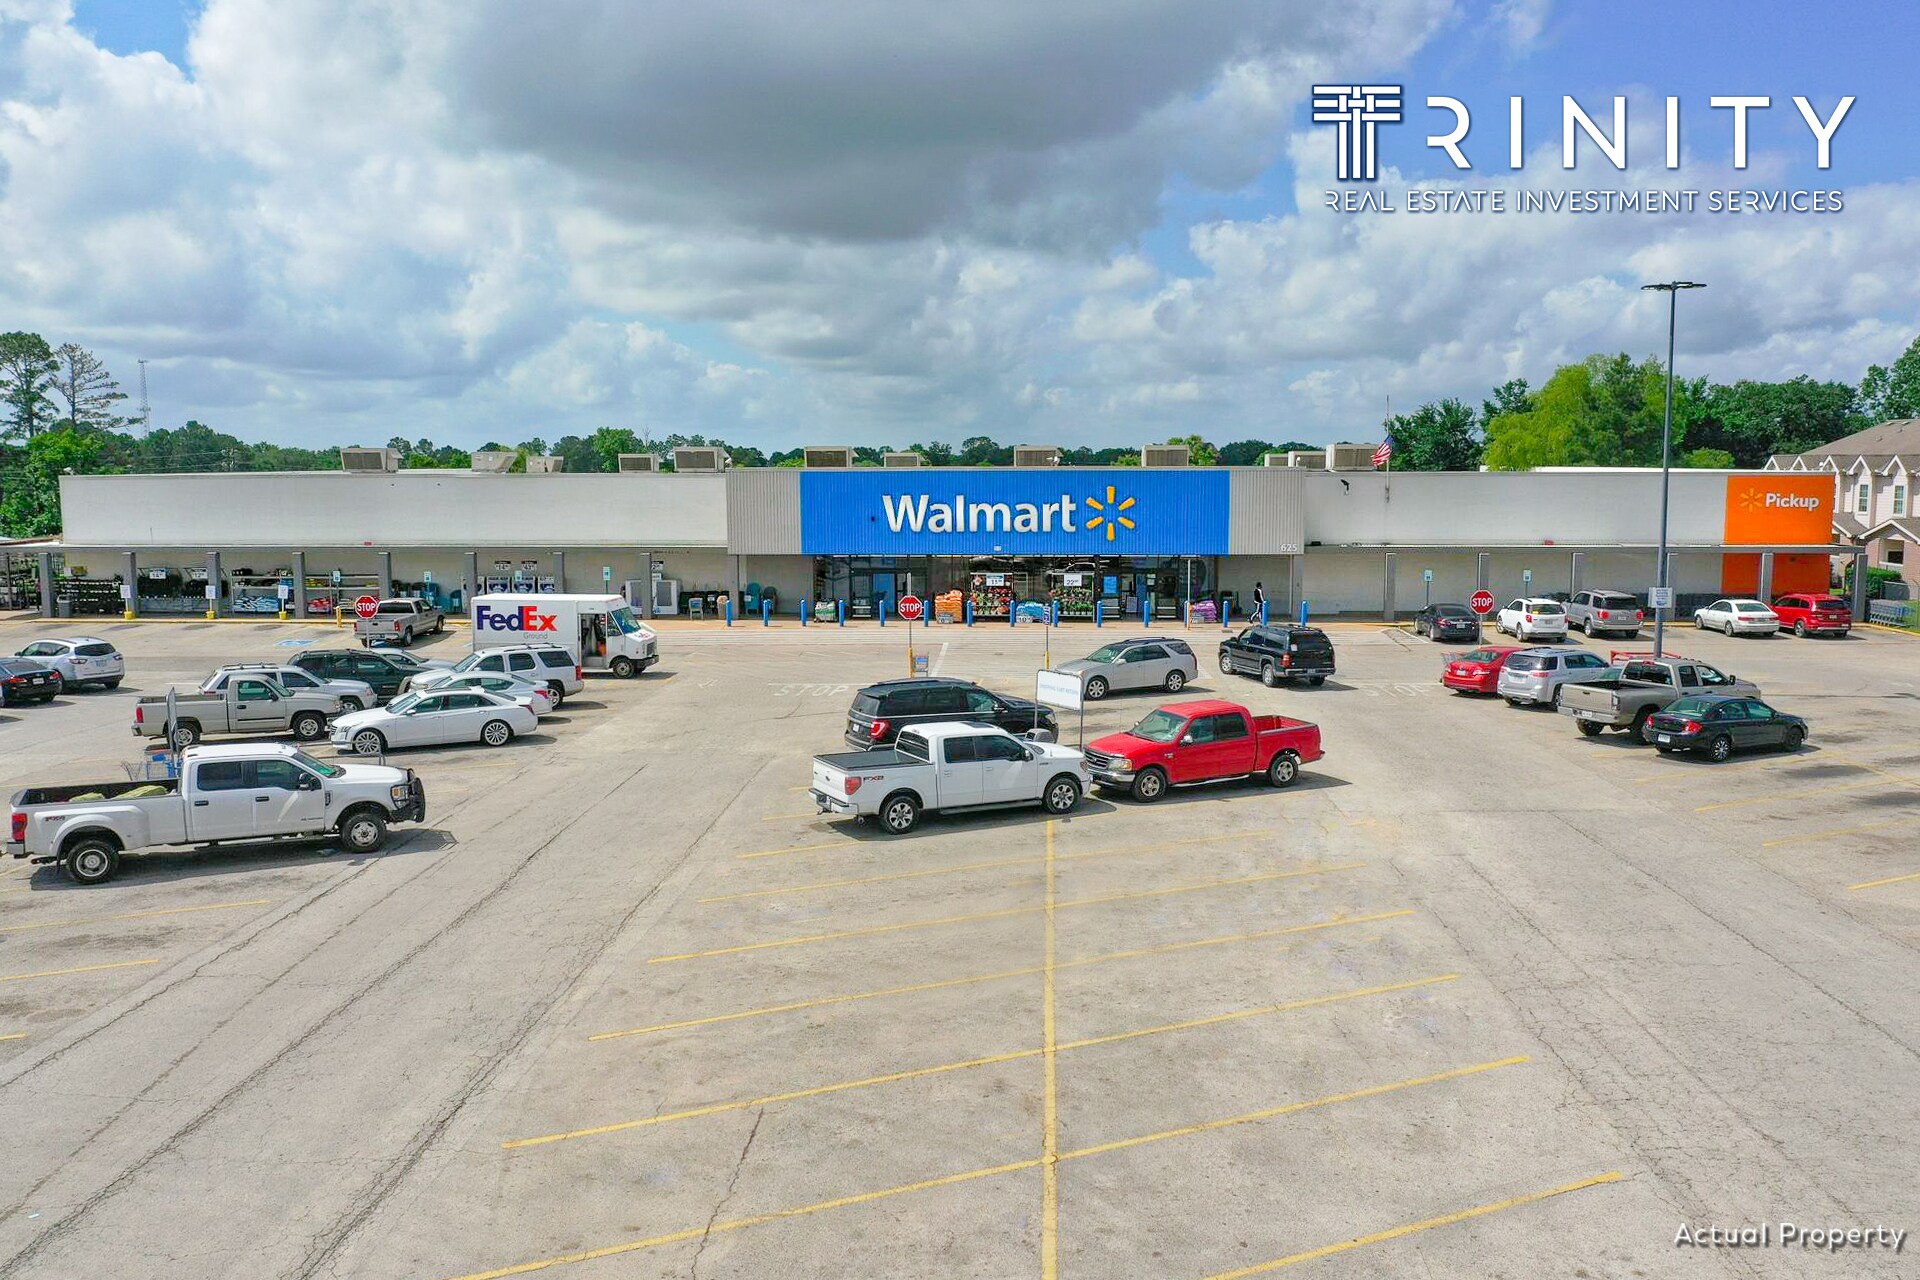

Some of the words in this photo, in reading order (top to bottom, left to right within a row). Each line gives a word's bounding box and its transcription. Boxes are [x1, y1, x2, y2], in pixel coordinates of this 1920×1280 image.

[1765, 493, 1819, 511] Pickup
[882, 494, 1077, 533] Walmart
[1280, 543, 1297, 552] 625
[356, 602, 376, 612] STOP
[1472, 597, 1492, 607] STOP
[900, 603, 920, 613] STOP
[476, 605, 558, 632] FedEx
[523, 632, 549, 641] Ground
[774, 685, 849, 697] STOP
